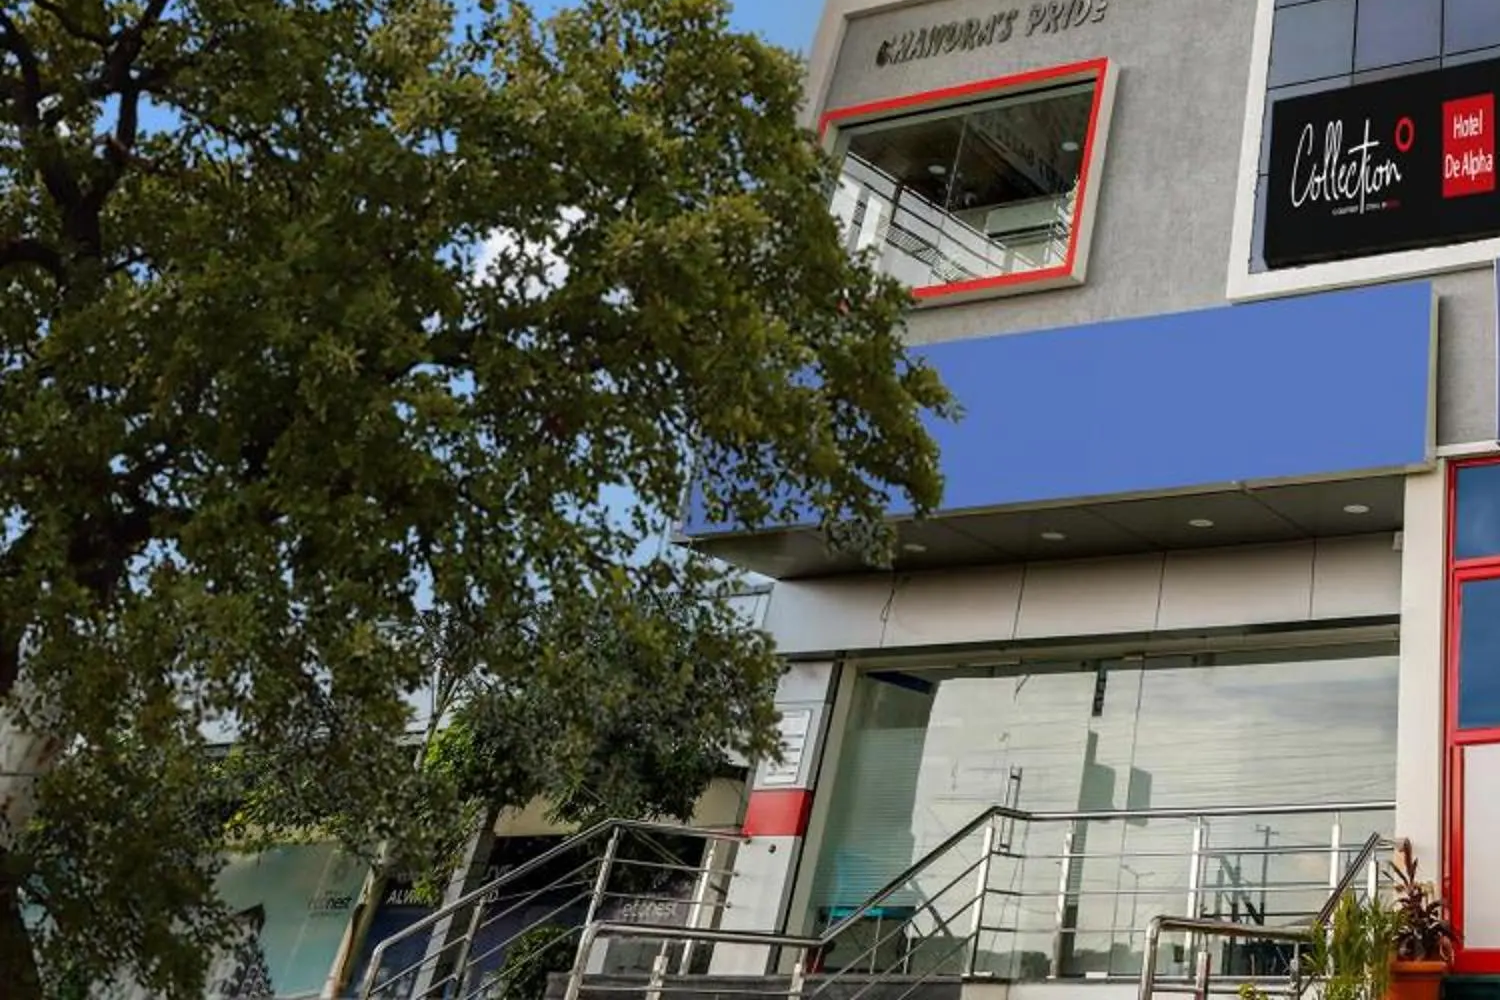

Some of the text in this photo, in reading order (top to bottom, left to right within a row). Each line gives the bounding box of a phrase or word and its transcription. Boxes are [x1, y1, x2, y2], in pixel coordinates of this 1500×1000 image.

[1453, 108, 1484, 139] Hotel
[1291, 118, 1401, 214] Collection
[1445, 147, 1493, 181] De Alpha
